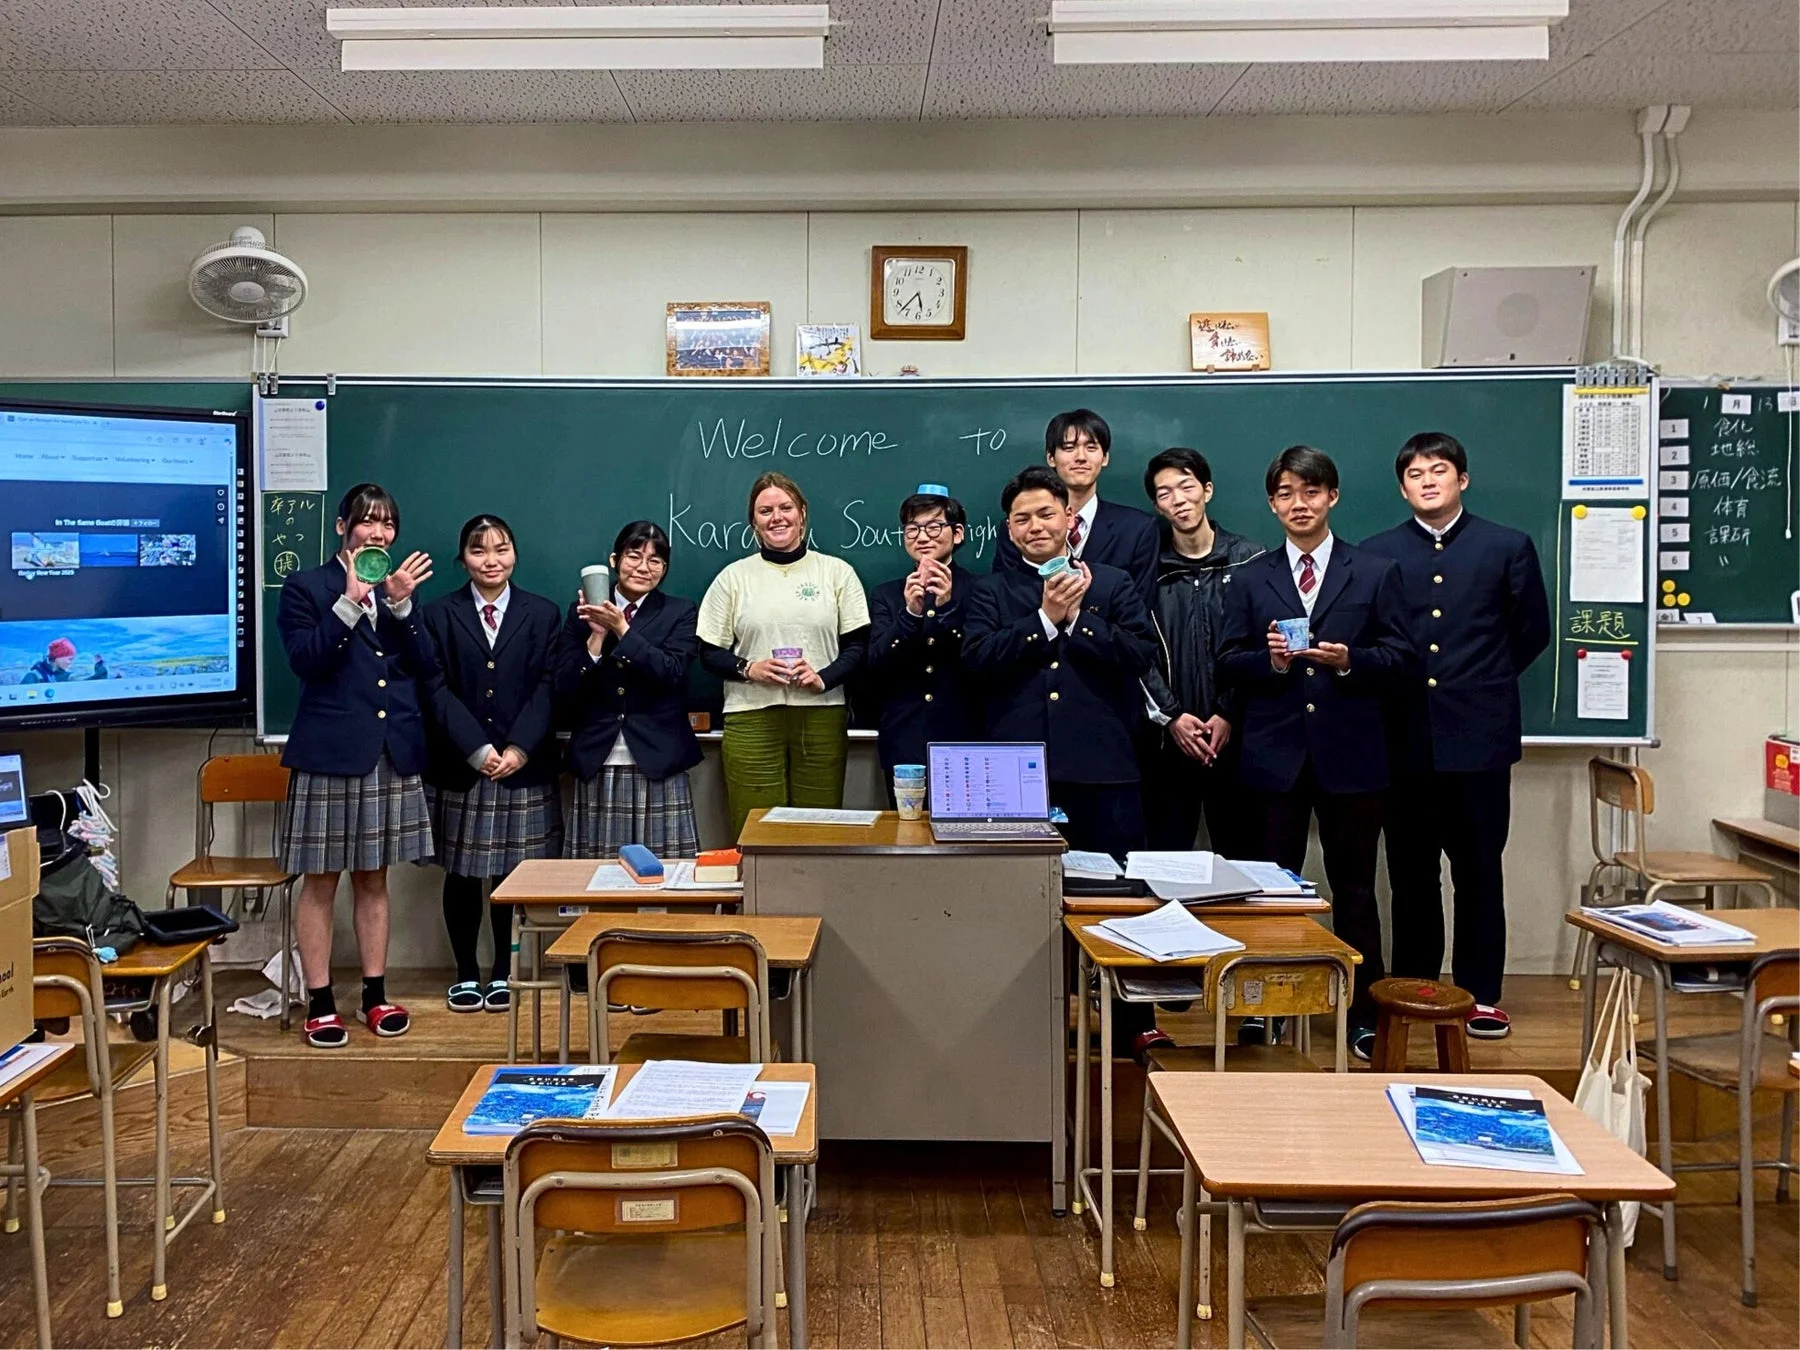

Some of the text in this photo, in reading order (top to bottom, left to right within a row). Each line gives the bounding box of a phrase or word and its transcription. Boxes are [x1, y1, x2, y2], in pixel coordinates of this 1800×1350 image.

[903, 267, 912, 277] 11
[915, 265, 925, 274] 12
[929, 268, 934, 277] 1
[895, 277, 905, 286] 10
[935, 277, 943, 286] 2
[892, 288, 900, 297] 9
[939, 288, 945, 298] 3
[895, 300, 903, 308] 8
[936, 299, 941, 309] 4
[904, 308, 911, 317] 7
[915, 311, 921, 320] 6
[925, 308, 932, 318] 5
[1732, 399, 1741, 409] 月
[1671, 424, 1676, 433] 1
[698, 417, 899, 459] Welcome
[1671, 451, 1678, 460] 2
[1671, 475, 1677, 485] 3
[1671, 503, 1678, 511] 4
[1713, 496, 1749, 518] 体育
[841, 500, 903, 549] Sout
[967, 516, 998, 559] igh
[1672, 528, 1679, 537] 5
[1671, 555, 1678, 565] 6
[1569, 609, 1631, 639] 課題
